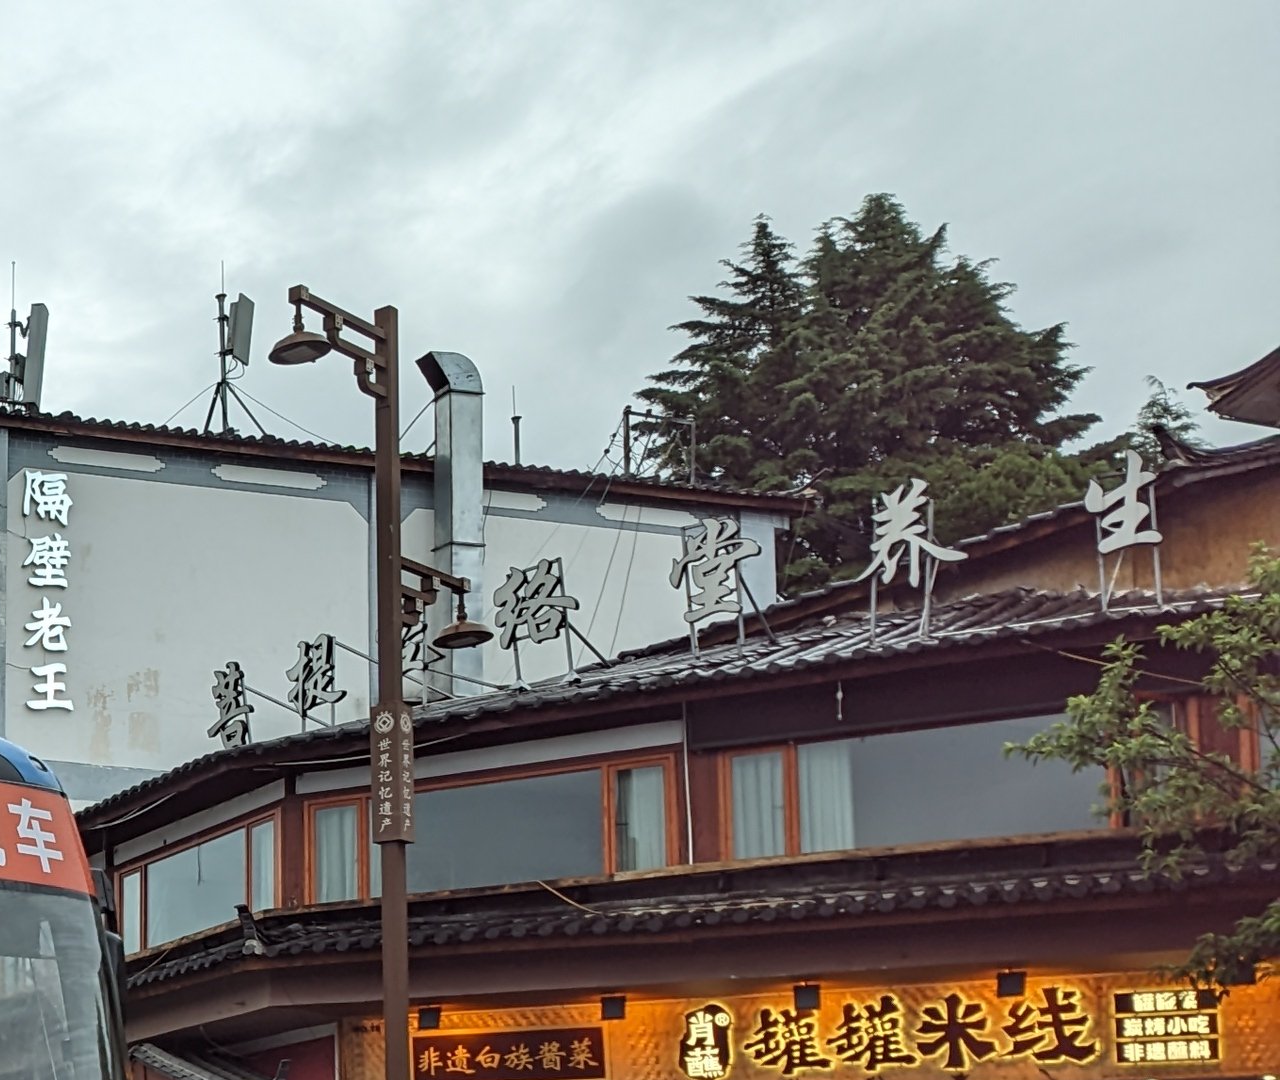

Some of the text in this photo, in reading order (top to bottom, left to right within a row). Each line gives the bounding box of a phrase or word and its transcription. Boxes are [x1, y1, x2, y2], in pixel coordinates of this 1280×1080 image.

[22, 469, 74, 712] 隔壁老王
[377, 737, 393, 833] 世界记忆遗产
[744, 985, 1102, 1075] 罐罐米线
[1123, 1014, 1210, 1037] 炭烤小吃
